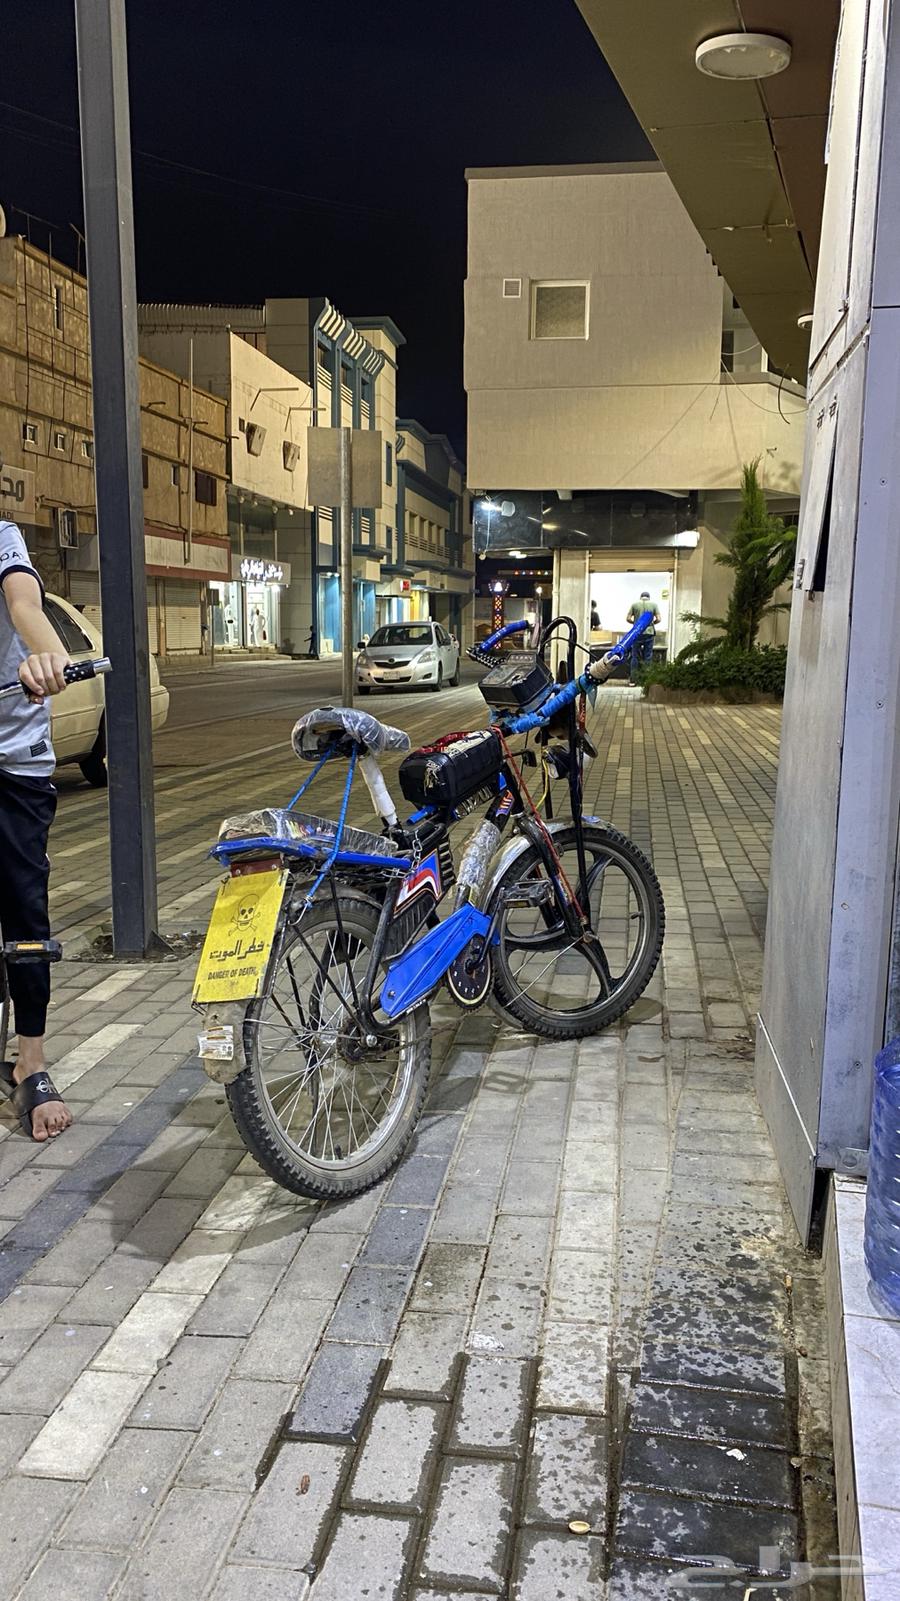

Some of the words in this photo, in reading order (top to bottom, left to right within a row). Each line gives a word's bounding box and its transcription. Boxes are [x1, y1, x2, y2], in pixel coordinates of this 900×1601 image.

[209, 939, 243, 962] الموت
[237, 937, 265, 960] خطر
[207, 970, 230, 980] DANGER
[230, 968, 239, 978] OF
[238, 966, 257, 977] DEATH
